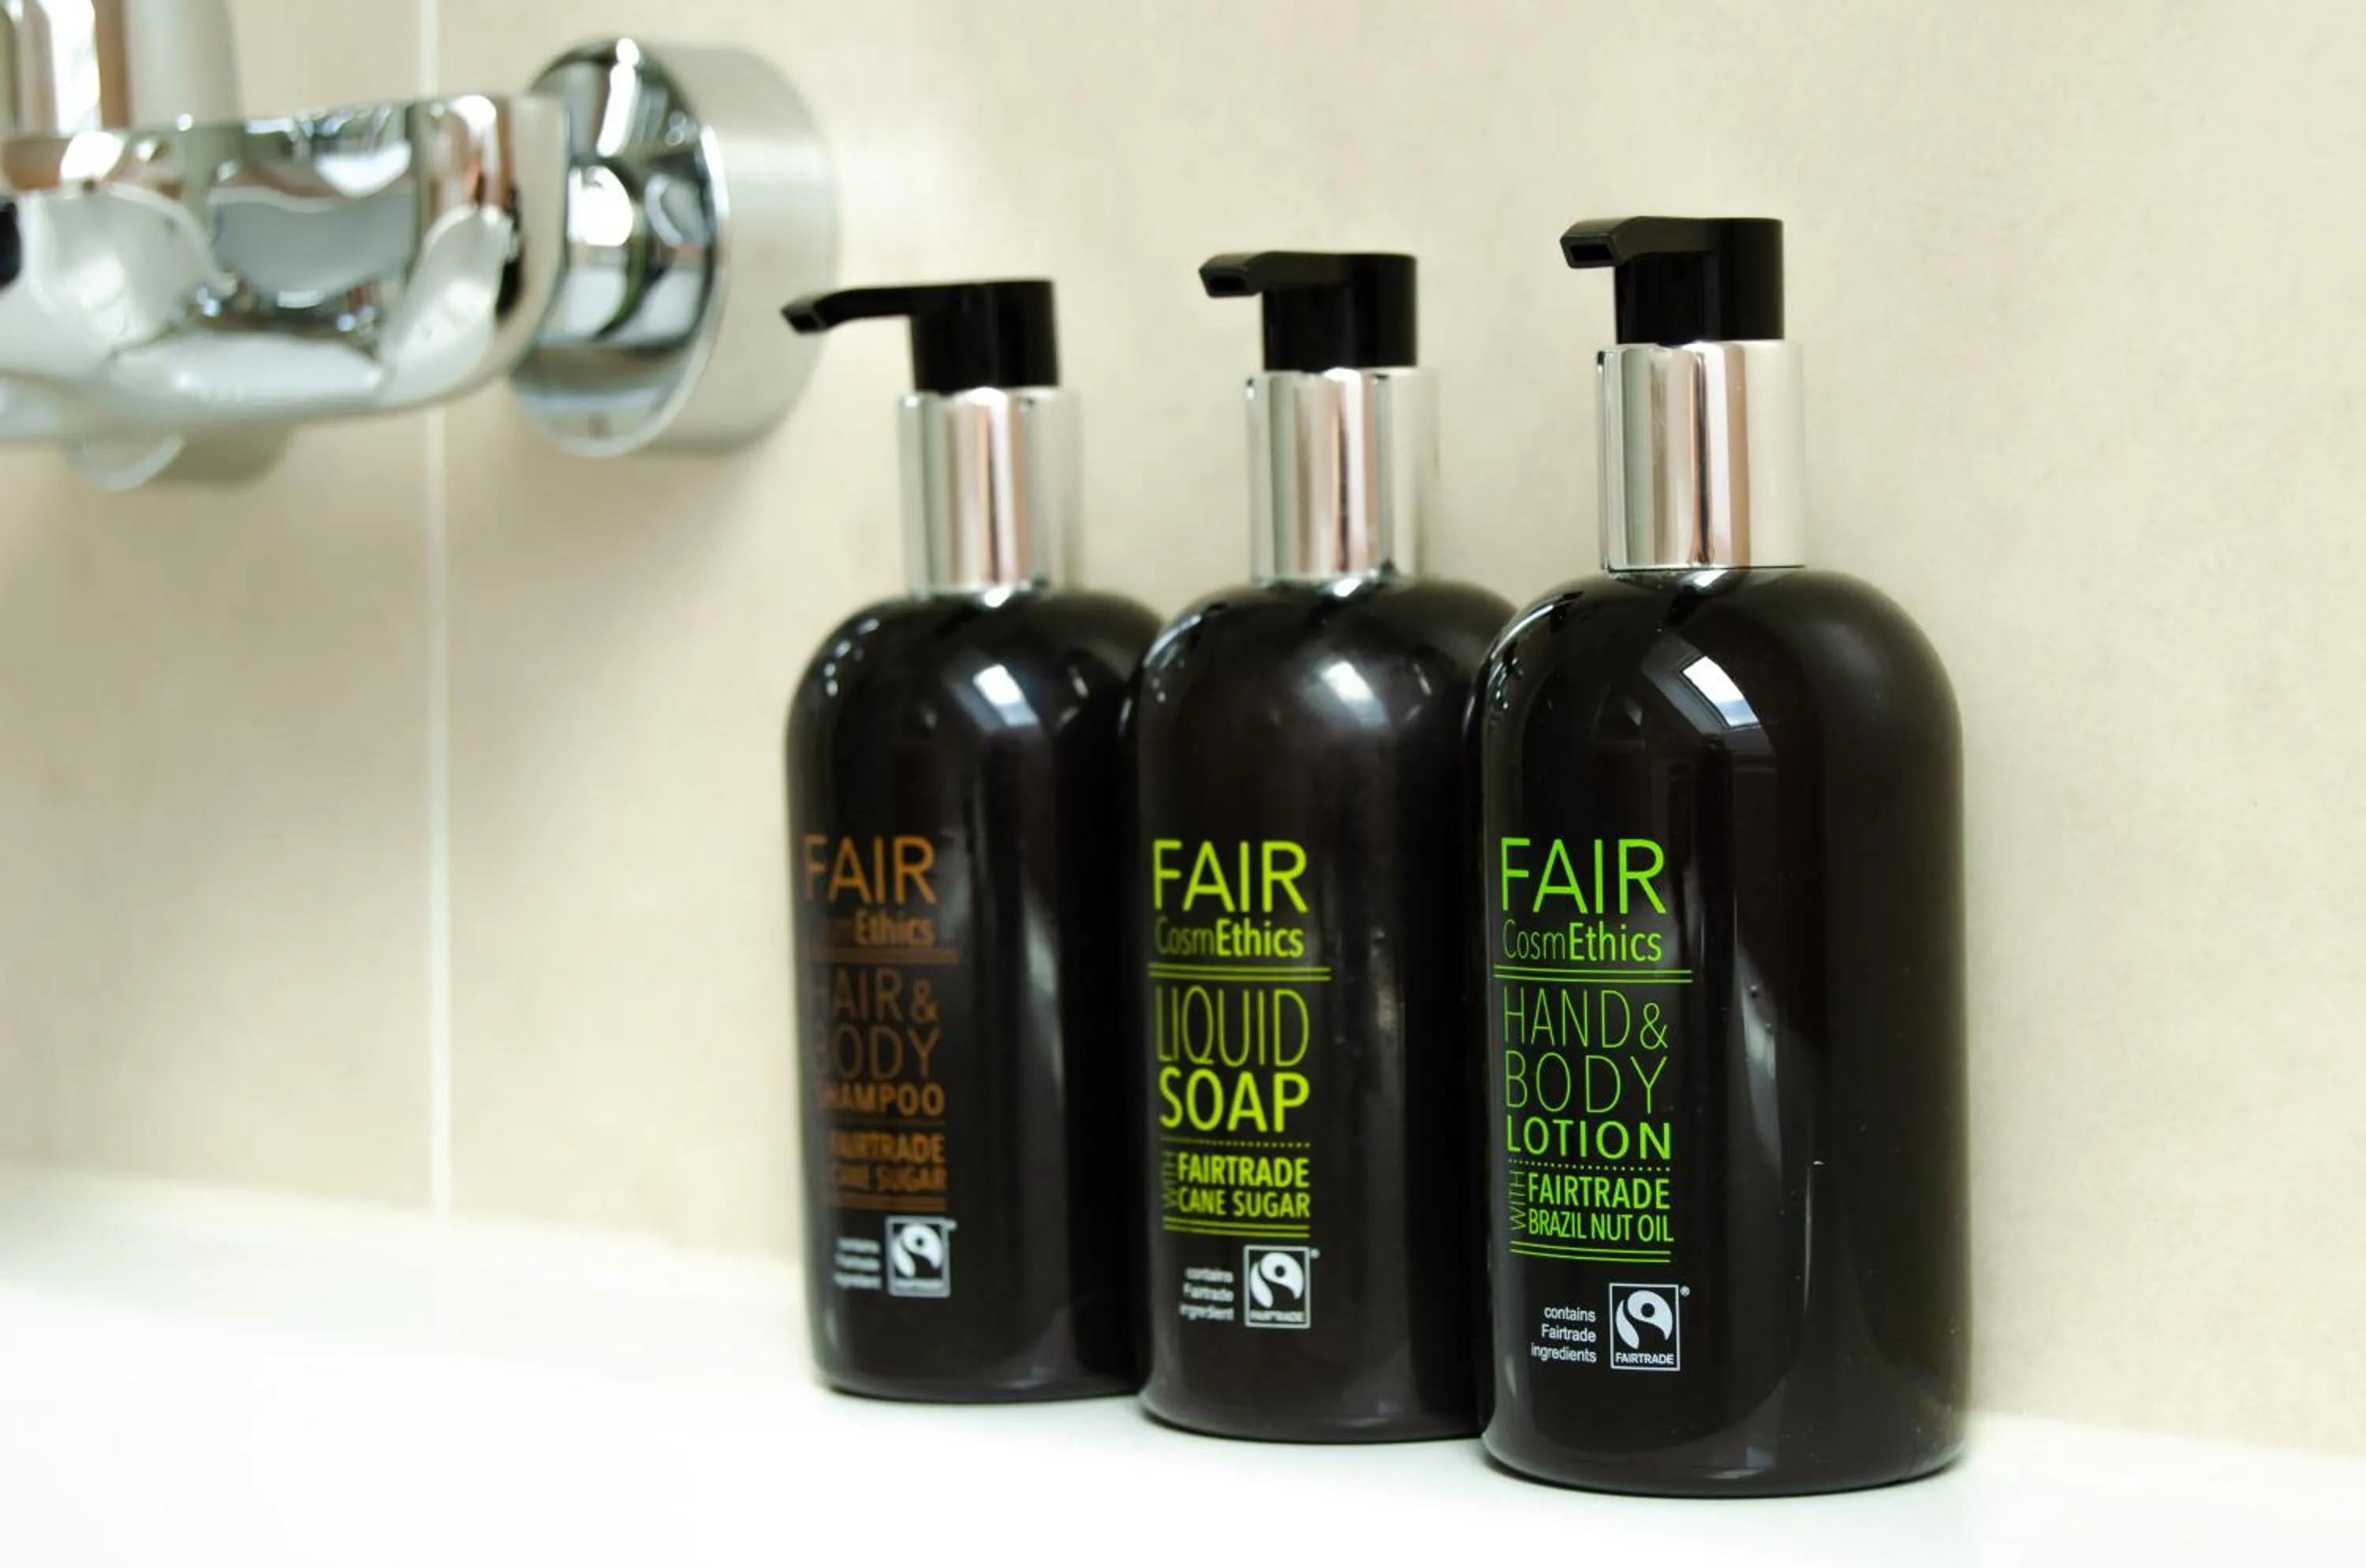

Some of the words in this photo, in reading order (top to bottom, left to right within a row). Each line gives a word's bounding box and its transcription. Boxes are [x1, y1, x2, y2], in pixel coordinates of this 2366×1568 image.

[803, 833, 937, 905] FAIR
[1153, 838, 1308, 913] FAIR
[1501, 837, 1666, 915] FAIR
[807, 909, 936, 946] Ethics
[1155, 915, 1304, 958] CosmEthics
[1502, 919, 1663, 961] CosmEthics
[1155, 985, 1310, 1068] LIQUID
[817, 1080, 946, 1117] AMPOO
[1159, 1066, 1311, 1133] SOAP
[1505, 1050, 1667, 1115] BODY
[1506, 1114, 1671, 1160] LOTION
[1177, 1152, 1311, 1189] FAIRTRADE
[1177, 1185, 1226, 1215] CANE
[1232, 1189, 1311, 1219] SUGAR
[1509, 1169, 1526, 1231] WITH
[1528, 1172, 1671, 1210] FAIRTRADE
[1528, 1208, 1587, 1240] BRAZIL
[1591, 1213, 1633, 1242] NUT
[1637, 1215, 1674, 1243] OIL
[1541, 1323, 1597, 1343] Fairtrade
[1543, 1305, 1596, 1323] contains
[1531, 1342, 1597, 1364] ingredients
[1614, 1352, 1675, 1366] FAIRTRADE
